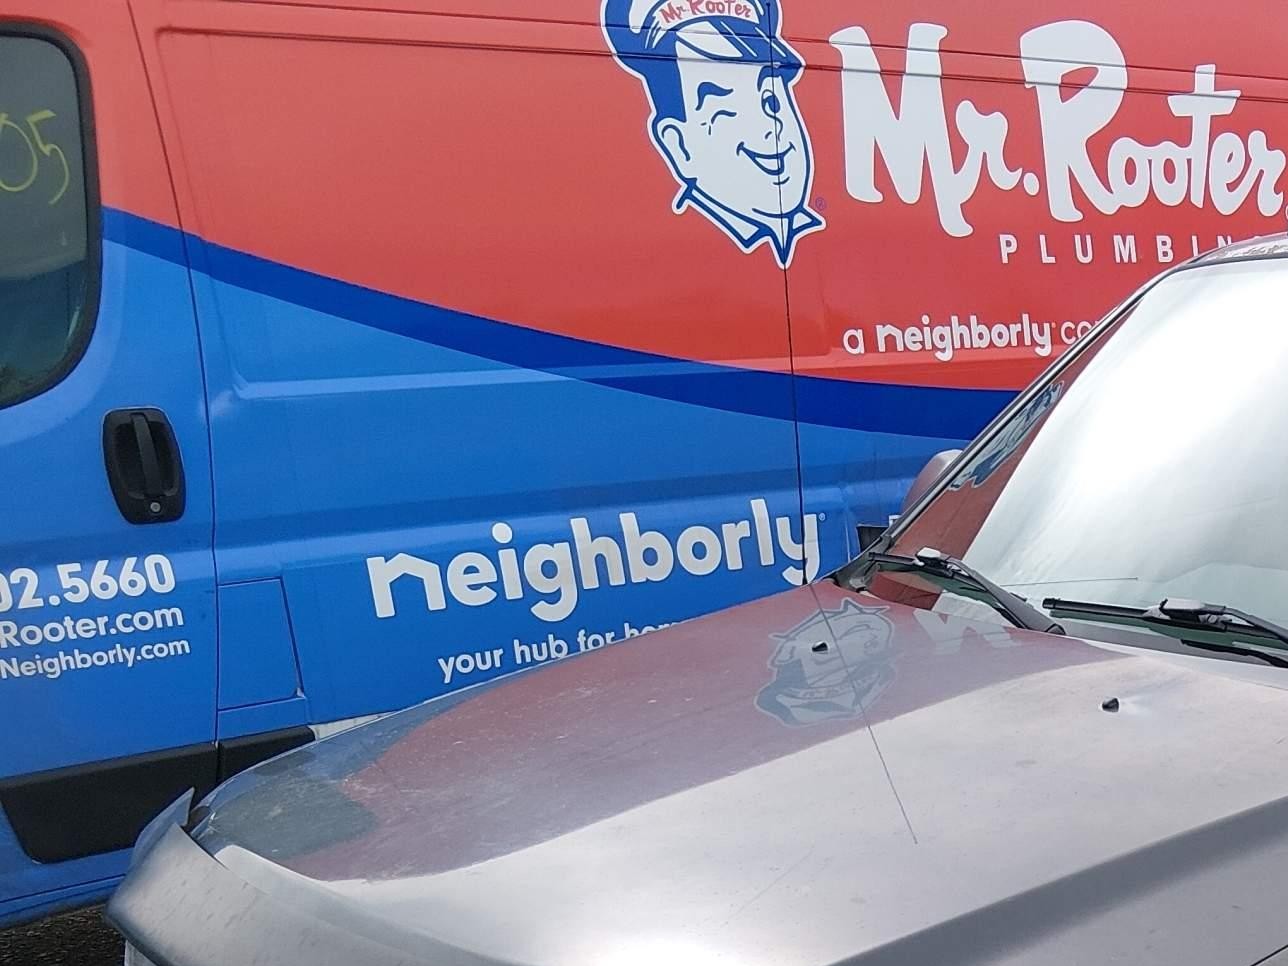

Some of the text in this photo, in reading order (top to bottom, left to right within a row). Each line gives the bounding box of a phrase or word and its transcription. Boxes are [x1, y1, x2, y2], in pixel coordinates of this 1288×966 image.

[689, 0, 752, 18] Rooter
[829, 19, 1287, 238] Mr. Rooter
[1000, 234, 1232, 264] PLUMBI
[843, 313, 1097, 362] a neighborly co
[366, 498, 819, 622] neighborly
[0, 607, 185, 649] Rooter.com
[0, 639, 191, 679] Neighborly.com
[437, 647, 503, 684] your
[513, 633, 569, 665] hub
[577, 629, 615, 652] for
